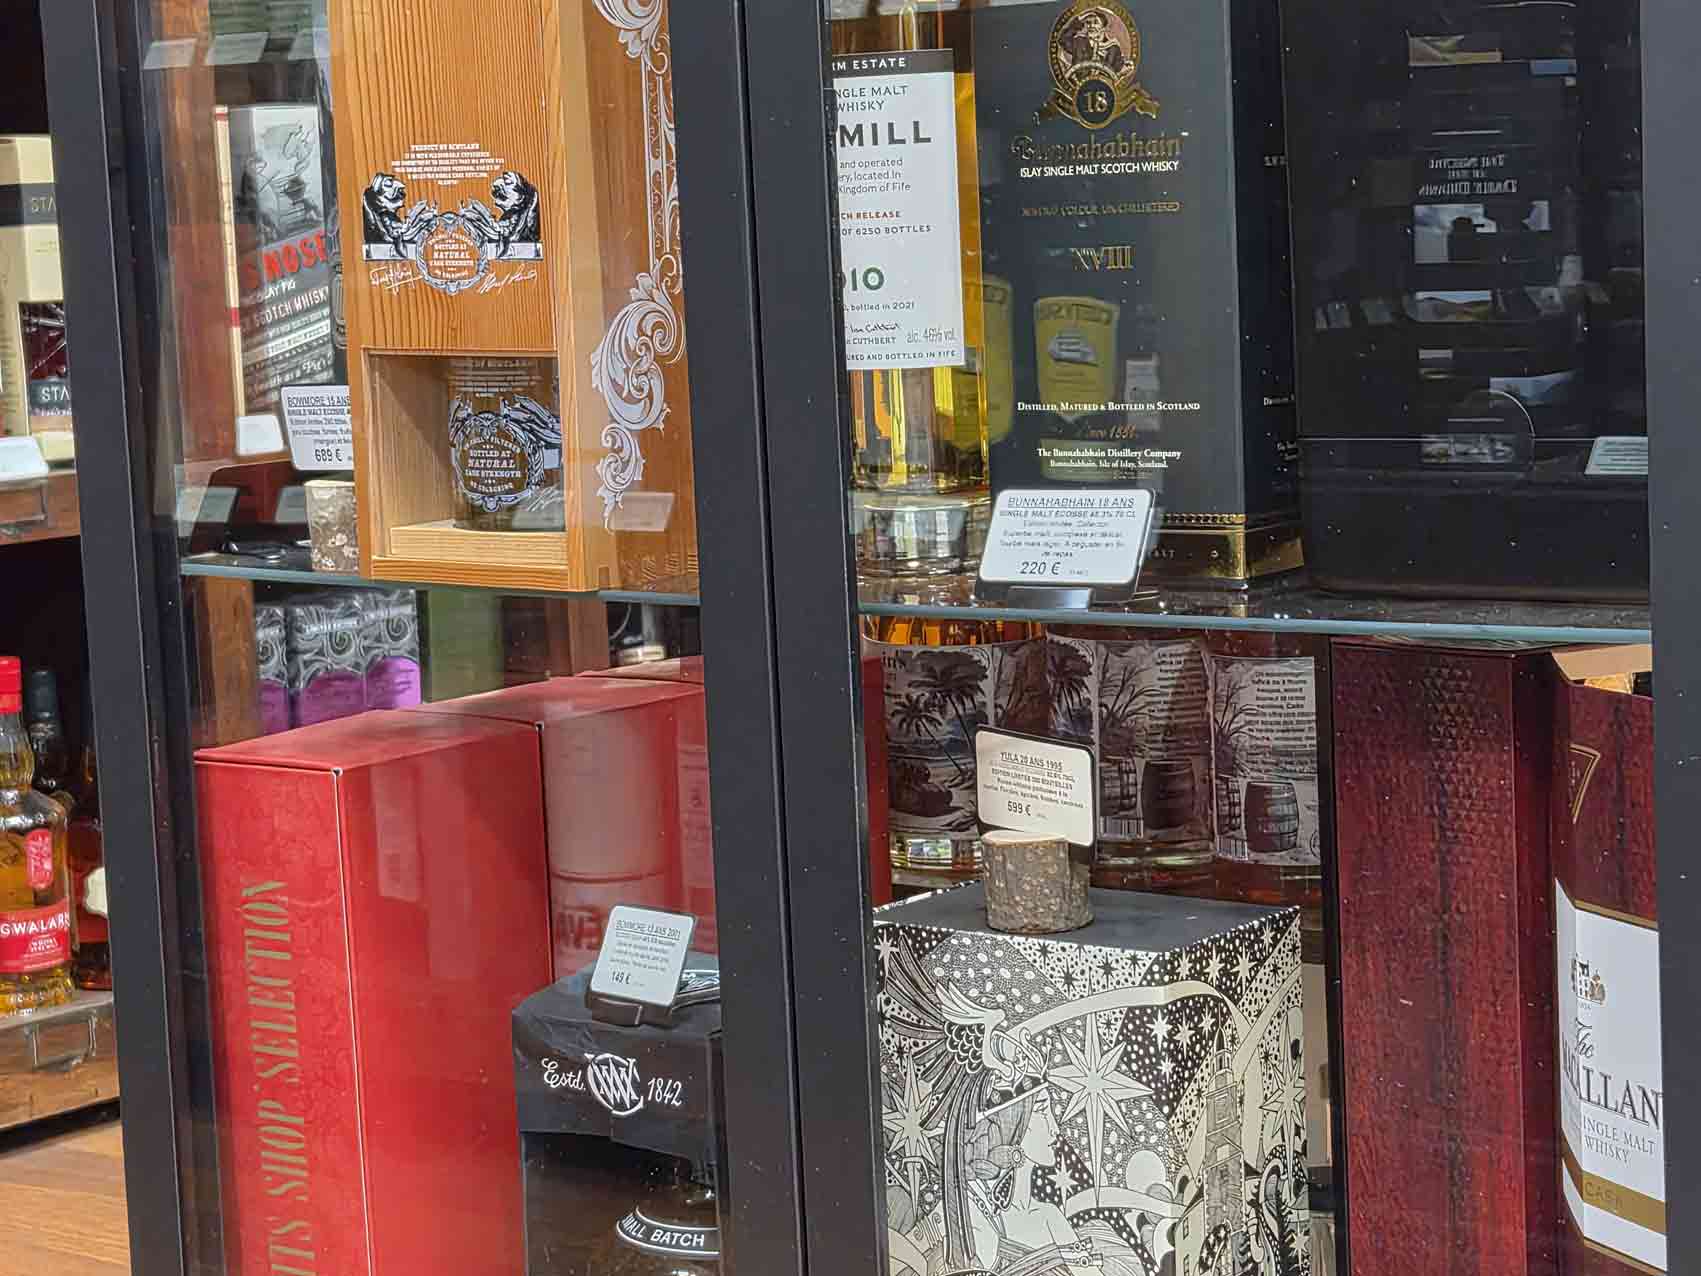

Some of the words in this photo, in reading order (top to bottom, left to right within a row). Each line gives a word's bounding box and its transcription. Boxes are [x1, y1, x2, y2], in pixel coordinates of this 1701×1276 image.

[853, 58, 907, 70] ESTATE
[871, 85, 909, 97] MALT
[1084, 91, 1107, 113] 18
[839, 120, 932, 148] MILL
[860, 157, 903, 169] operated
[1020, 167, 1042, 178] ISLAY
[1043, 166, 1074, 177] SINGLE
[1076, 164, 1100, 176] MALT
[1101, 162, 1140, 175] SCOTCH
[1141, 160, 1179, 172] WHISKY
[854, 170, 891, 181] located
[880, 183, 890, 193] of
[892, 181, 912, 193] Fife
[855, 210, 902, 220] RELEASE
[842, 227, 853, 237] OF
[855, 226, 882, 236] 6250
[885, 224, 931, 234] BOTTLES
[851, 302, 881, 312] bottled
[892, 301, 915, 311] 2021
[852, 336, 897, 346] CUTHBERT
[867, 352, 883, 361] AND
[885, 352, 924, 361] BOTTLED
[926, 351, 936, 360] IN
[288, 396, 325, 406] BOWMORE
[315, 448, 333, 462] 689
[336, 448, 343, 462] €
[469, 449, 499, 458] BOTTLED
[500, 449, 512, 458] AT
[1036, 447, 1052, 458] The
[1053, 447, 1106, 458] Bunnahabhain
[1107, 447, 1142, 460] Distillery
[1143, 448, 1182, 460] Company
[467, 459, 516, 469] NATURAL
[1007, 497, 1095, 507] BUNNAHABHAIN
[1098, 497, 1108, 507] 18
[1110, 497, 1135, 507] ANS
[1019, 561, 1047, 576] 220
[1051, 561, 1061, 576] €
[1029, 756, 1045, 767] ANS
[1007, 800, 1023, 814] 599
[1025, 804, 1031, 816] €
[0, 911, 71, 938] GWALARN
[240, 878, 300, 1088] SELECTION
[542, 1058, 587, 1091] Estd.
[647, 1077, 683, 1107] 1842
[255, 1099, 309, 1202] SHOP
[1584, 1136, 1631, 1163] WHISKY
[1623, 1131, 1656, 1157] MALT
[650, 1229, 705, 1248] BATCH
